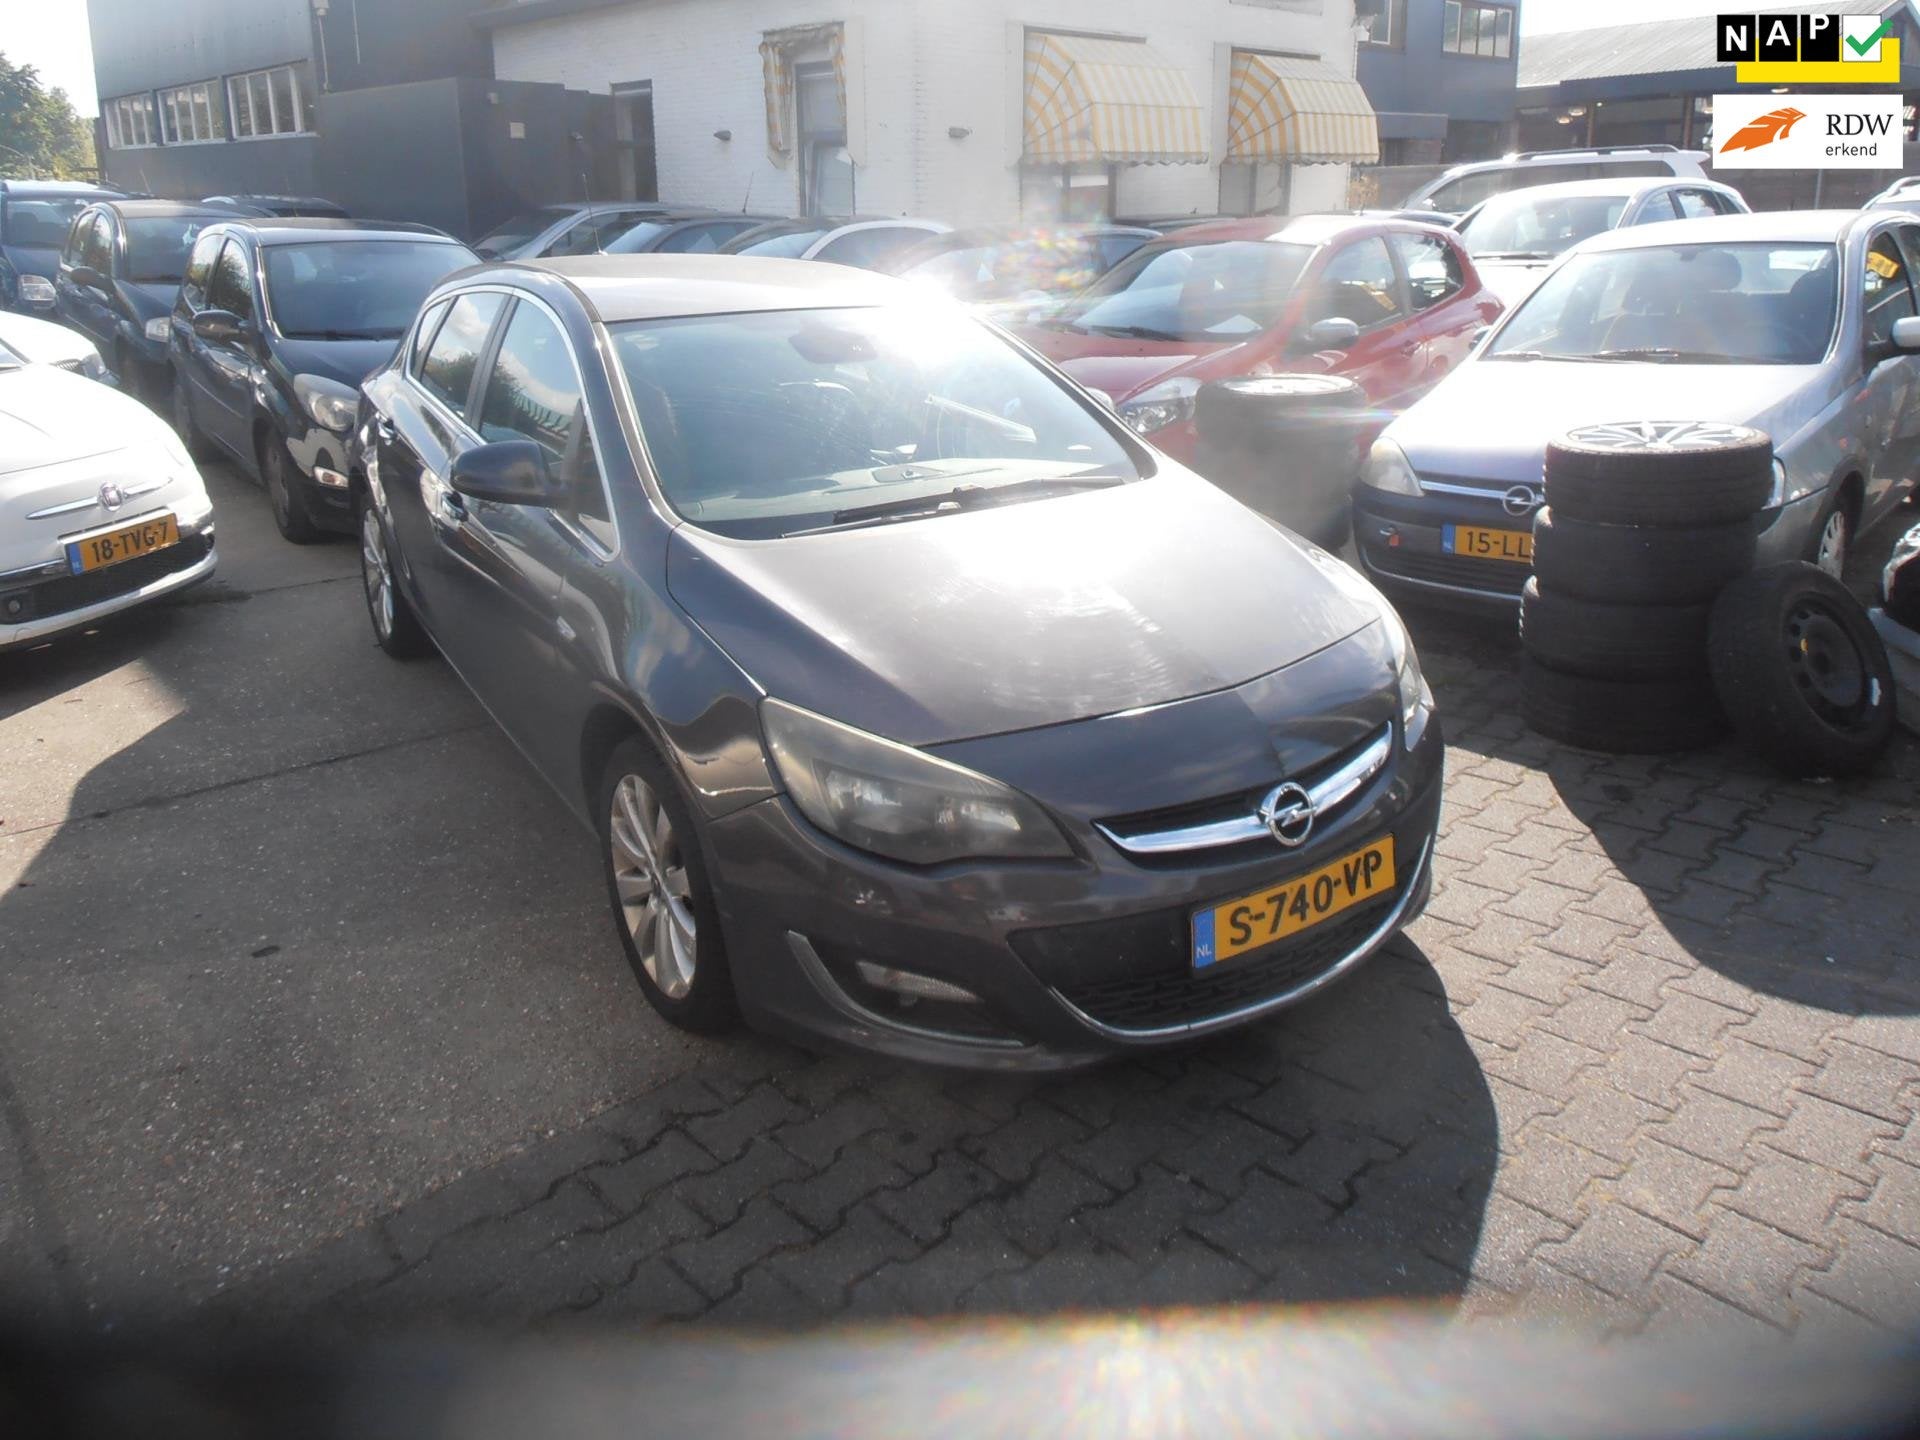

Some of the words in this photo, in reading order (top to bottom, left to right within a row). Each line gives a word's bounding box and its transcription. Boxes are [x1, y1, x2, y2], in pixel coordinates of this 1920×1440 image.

[91, 521, 168, 563] 18-TVG-7
[1229, 849, 1383, 946] S-740-VP
[1195, 943, 1212, 958] NL
